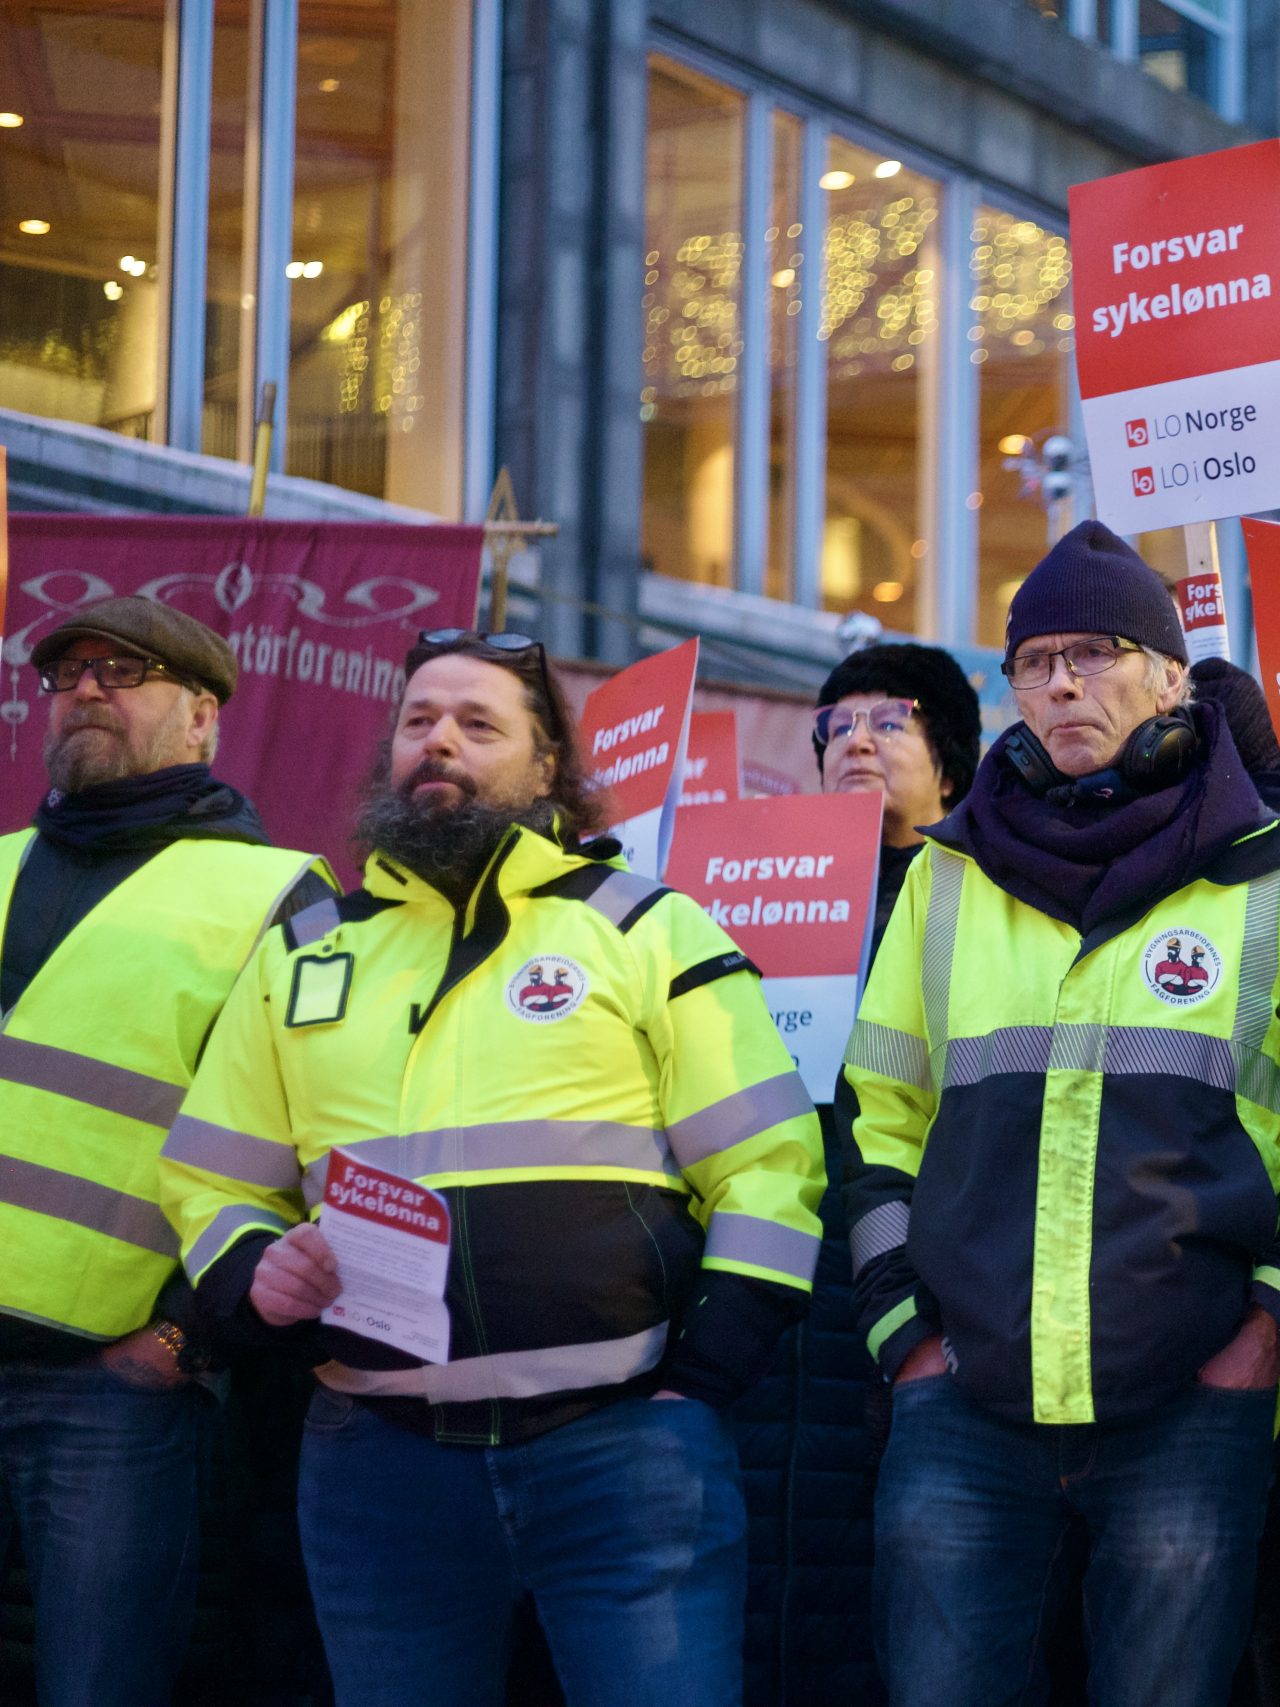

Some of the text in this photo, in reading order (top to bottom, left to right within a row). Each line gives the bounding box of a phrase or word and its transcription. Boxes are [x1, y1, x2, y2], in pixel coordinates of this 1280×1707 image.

[1112, 223, 1244, 275] Forsvar
[1092, 272, 1272, 338] sykelønna
[1185, 404, 1257, 433] Norge
[1203, 452, 1256, 480] Oslo
[592, 704, 665, 757] Forsvar
[704, 854, 835, 885] Forsvar
[702, 896, 850, 927] kelønna
[1144, 928, 1221, 967] BYGNINGSARBEIDERNES
[1150, 983, 1211, 1005] FAGFORENING
[344, 1166, 425, 1207] Forsvar
[330, 1181, 440, 1232] sykelønna
